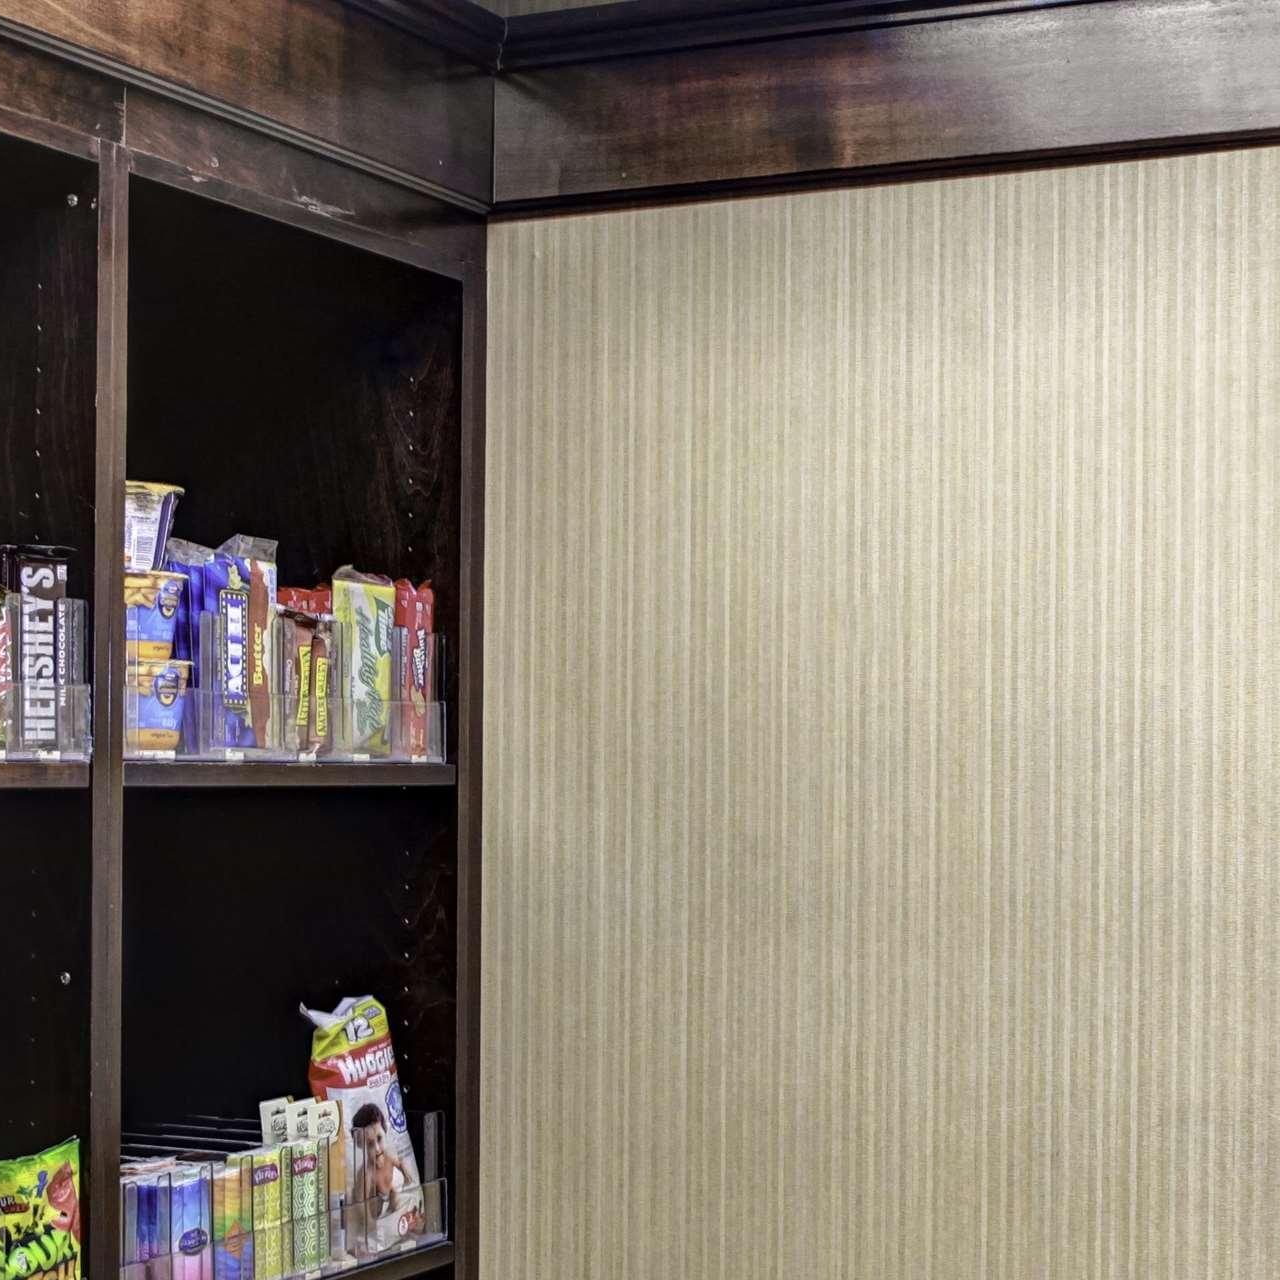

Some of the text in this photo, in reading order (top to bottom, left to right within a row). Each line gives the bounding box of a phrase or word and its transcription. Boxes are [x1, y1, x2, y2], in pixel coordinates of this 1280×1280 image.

[20, 566, 56, 743] HERSHEY'S
[253, 624, 264, 685] Butter
[344, 1016, 375, 1045] 12
